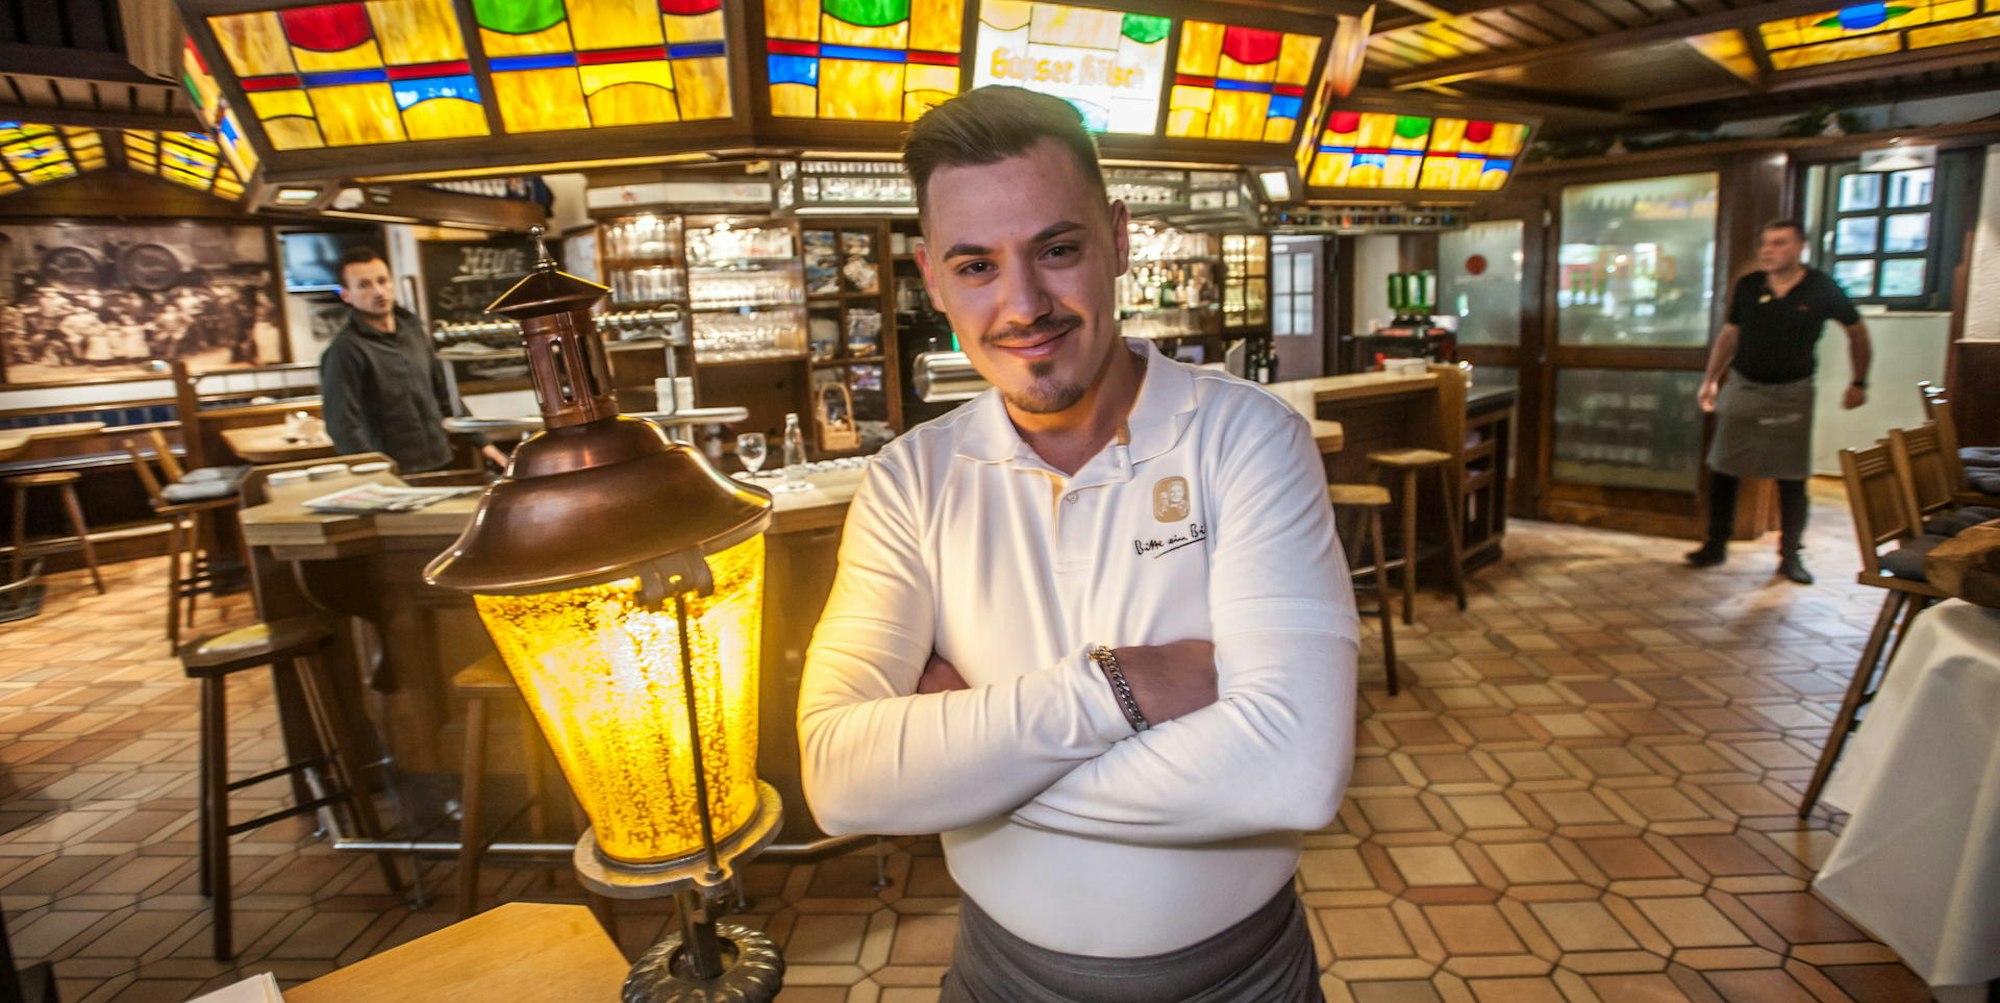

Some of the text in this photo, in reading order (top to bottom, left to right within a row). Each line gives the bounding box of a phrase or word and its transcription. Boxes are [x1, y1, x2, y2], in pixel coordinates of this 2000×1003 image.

[1135, 523, 1206, 555] Bitte ein Bi
